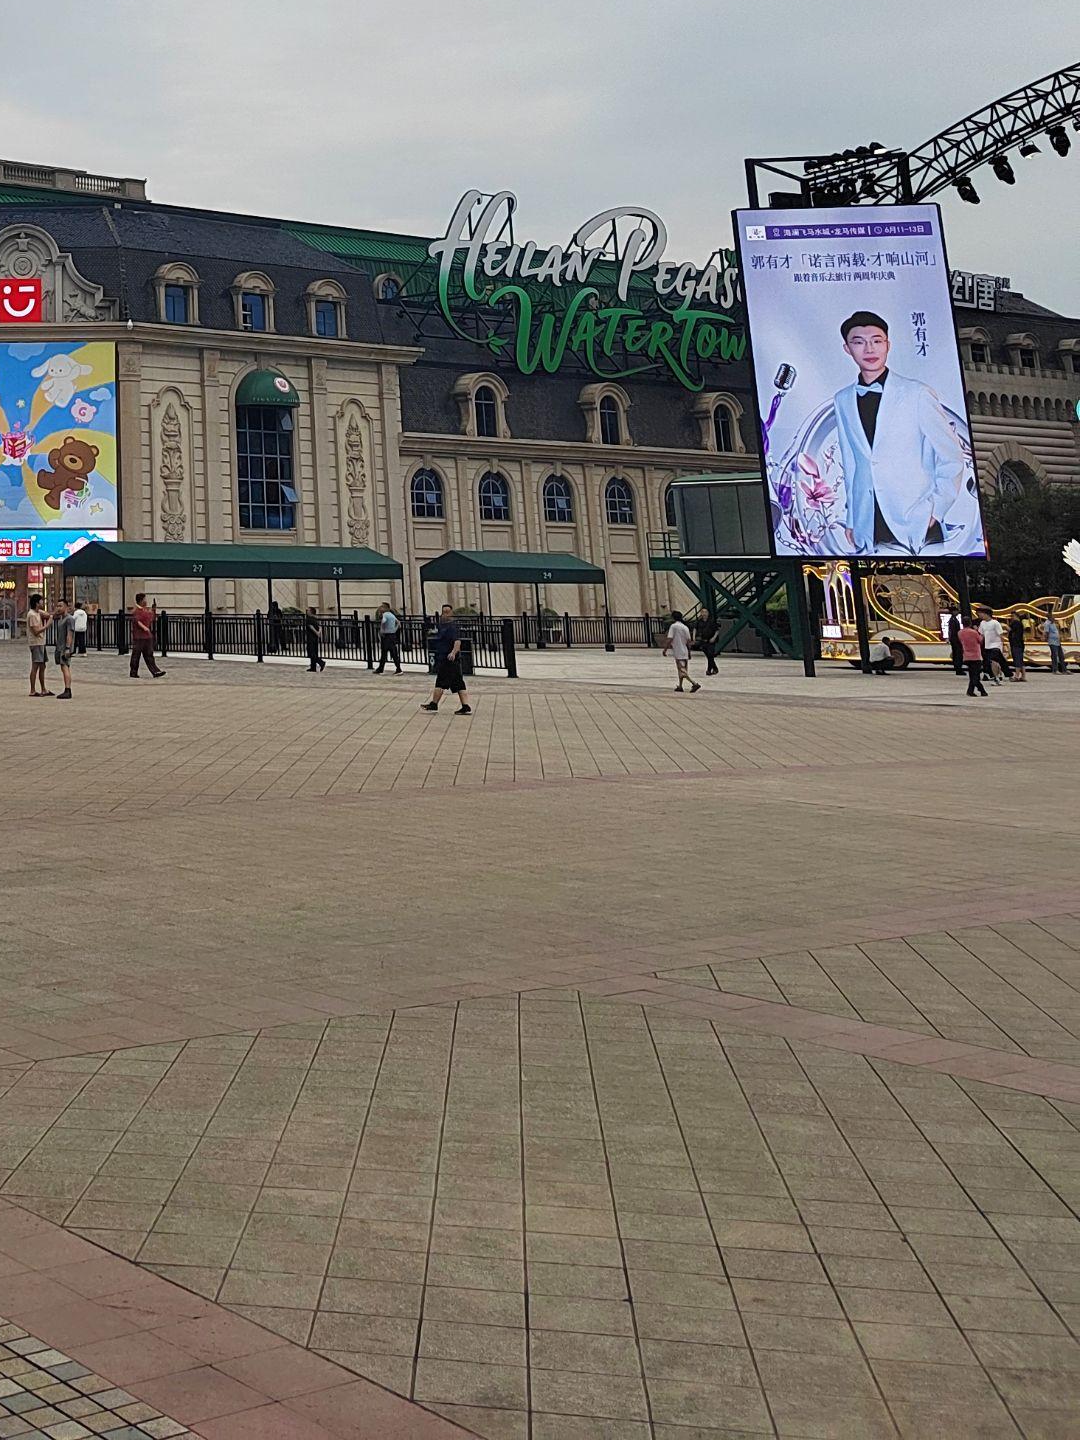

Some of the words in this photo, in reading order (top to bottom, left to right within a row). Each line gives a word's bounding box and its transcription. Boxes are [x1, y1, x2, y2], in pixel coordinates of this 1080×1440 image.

[884, 225, 925, 234] 6月11-13日
[575, 206, 742, 315] PEGAS
[911, 311, 930, 357] 郭有才
[192, 564, 203, 573] 2-7
